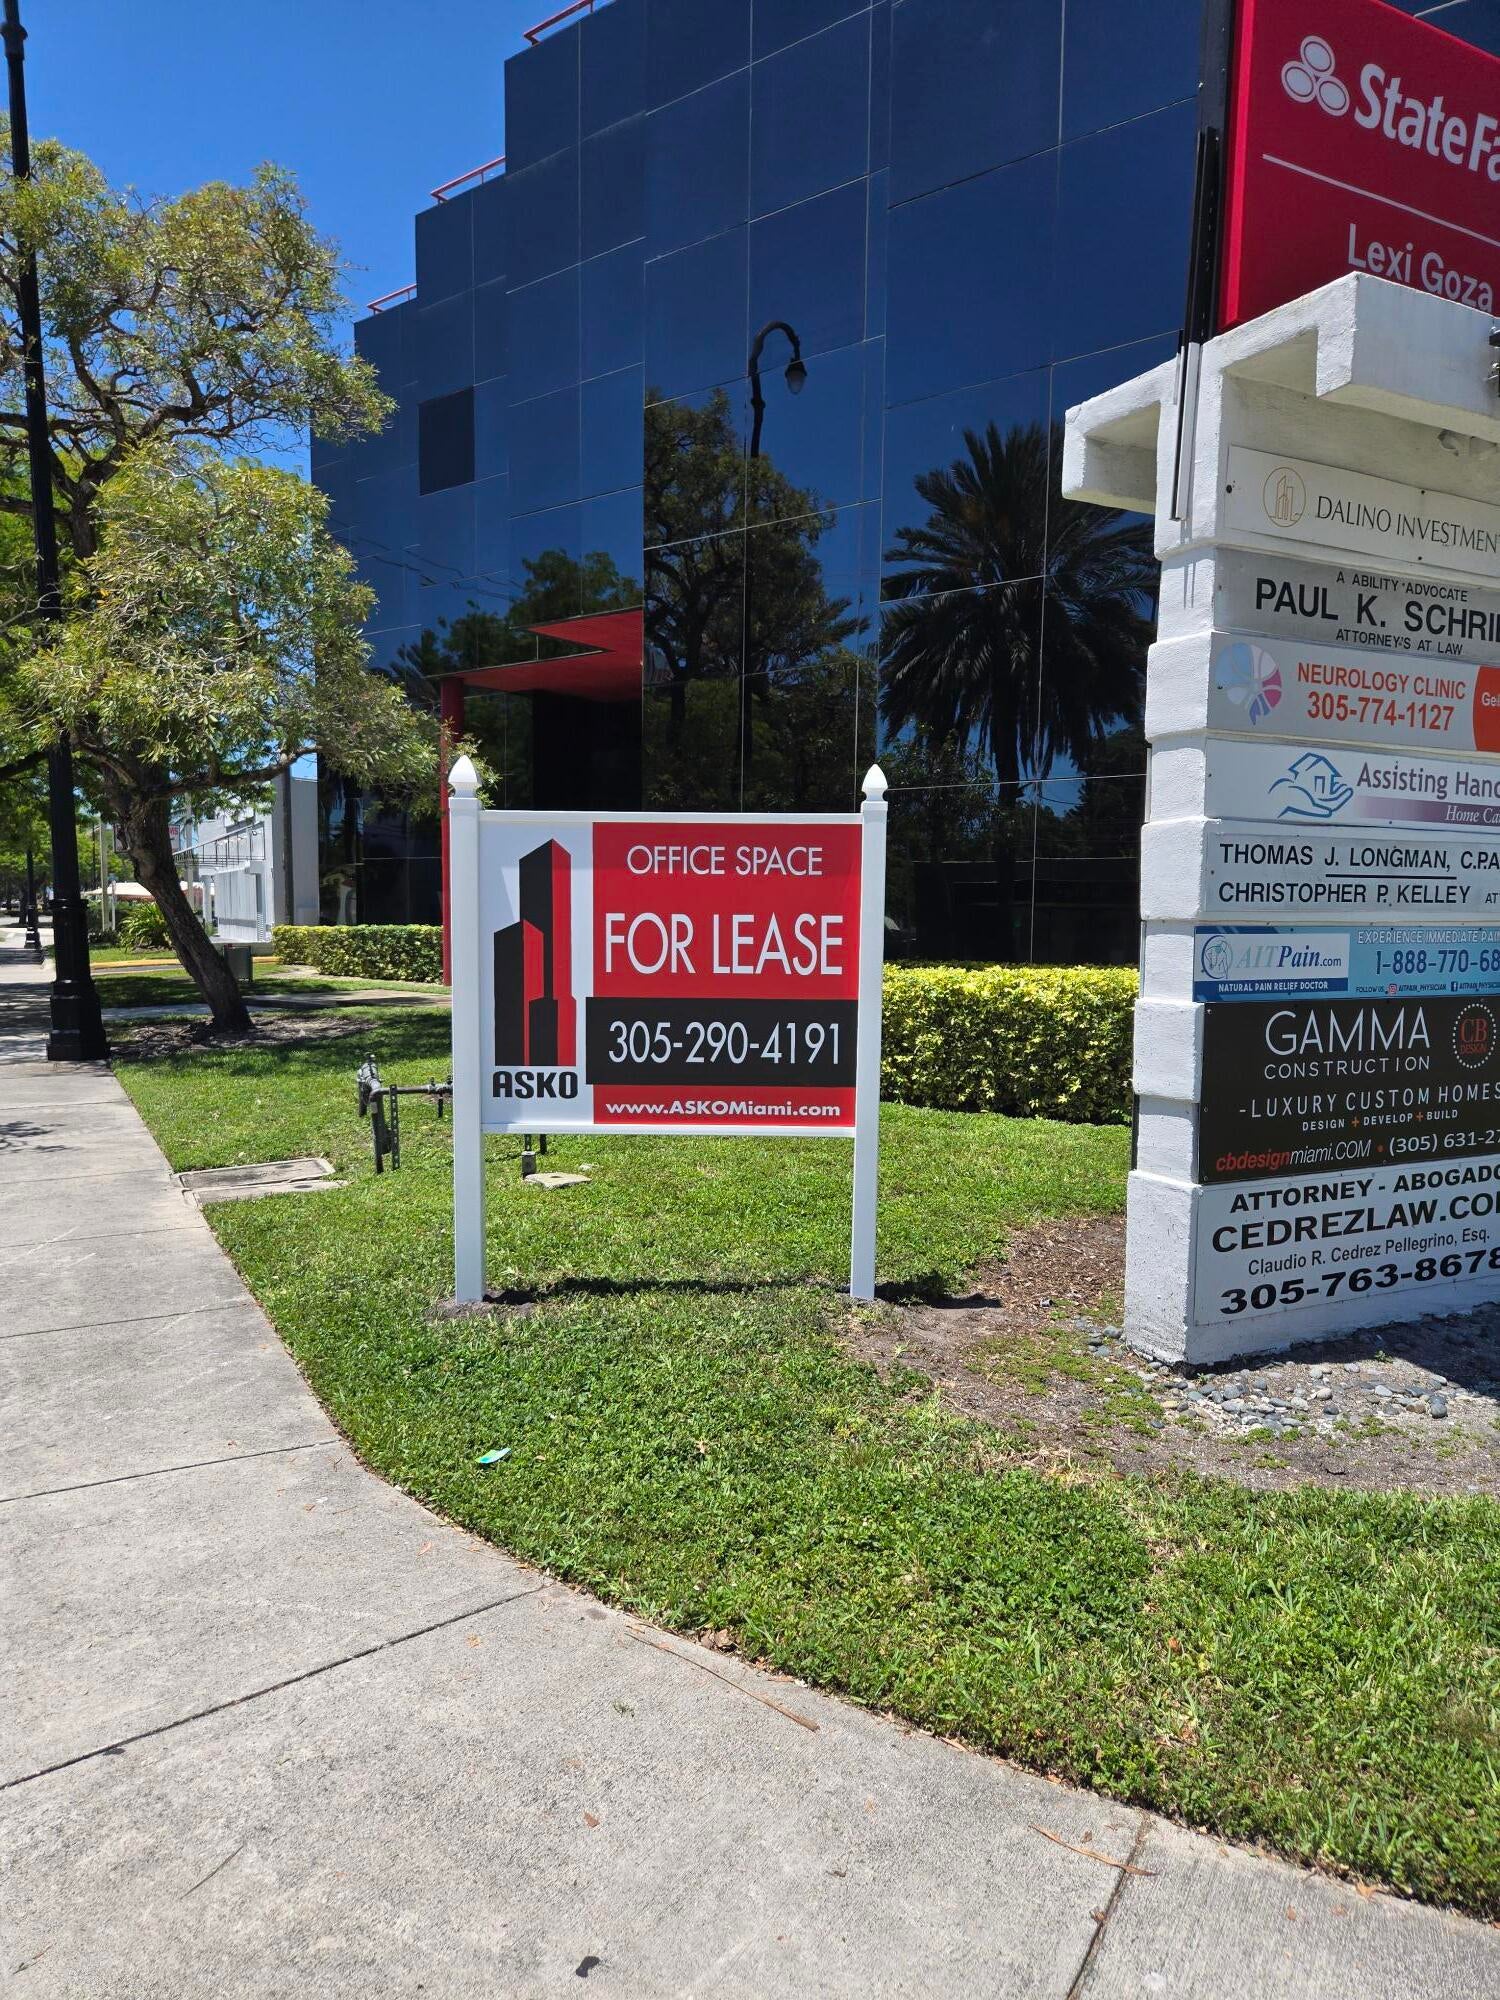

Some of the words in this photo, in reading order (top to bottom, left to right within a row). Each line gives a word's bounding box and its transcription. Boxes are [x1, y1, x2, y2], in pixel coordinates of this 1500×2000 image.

[1348, 223, 1413, 283] Lexi
[1421, 252, 1493, 313] Goza
[1316, 496, 1391, 532] DALINO
[1336, 571, 1345, 584] A
[1352, 574, 1399, 591] ABILITY
[1256, 577, 1339, 621] PAUL
[1356, 593, 1386, 627] K.
[1417, 639, 1432, 652] AT
[1437, 641, 1464, 655] LAW
[1297, 661, 1410, 693] NEUROLOGY
[1413, 676, 1466, 699] CLINIC
[1307, 691, 1455, 731] 305-774-1127
[1356, 762, 1448, 800] Assisting
[1445, 805, 1480, 823] Home
[1483, 807, 1500, 824] Ca
[626, 845, 726, 876] OFFICE
[735, 845, 823, 877] SPACE
[1220, 843, 1313, 866] THOMAS
[1325, 847, 1339, 867] J.
[1350, 848, 1451, 872] LONGMAN,
[1218, 882, 1366, 903] CHRISTOPHER
[1377, 885, 1388, 904] P.
[1397, 884, 1471, 904] KELLEY
[605, 911, 696, 975] FOR
[713, 911, 843, 976] LEASE
[1358, 930, 1423, 944] EXPERIENCE
[1424, 930, 1478, 943] IMMEDIATE
[1218, 983, 1253, 992] NATURAL
[1255, 982, 1272, 991] PAIN
[1273, 982, 1298, 990] RELIEF
[1300, 981, 1328, 990] DOCTOR
[608, 1020, 840, 1065] 305-290-4191
[1265, 1006, 1430, 1056] GAMMA
[1264, 1056, 1430, 1080] CONSTRUCTION
[492, 1070, 578, 1099] ASKO
[1346, 1087, 1430, 1111] CUSTOM
[605, 1099, 841, 1117] www.ASKOMiami.com
[1302, 1118, 1345, 1131] DESIGN
[1363, 1112, 1414, 1126] DEVELOP
[1426, 1109, 1458, 1121] BUILD
[1389, 1134, 1438, 1156] (305)
[1230, 1179, 1374, 1214] ATTORNEY
[1212, 1190, 1500, 1253] CEDREZLAW.CO
[1248, 1253, 1306, 1276] Claudio
[1312, 1250, 1326, 1266] R.
[1331, 1246, 1381, 1262] Cedrez
[1385, 1234, 1457, 1256] Pellegrino,
[1462, 1228, 1490, 1245] Esq.
